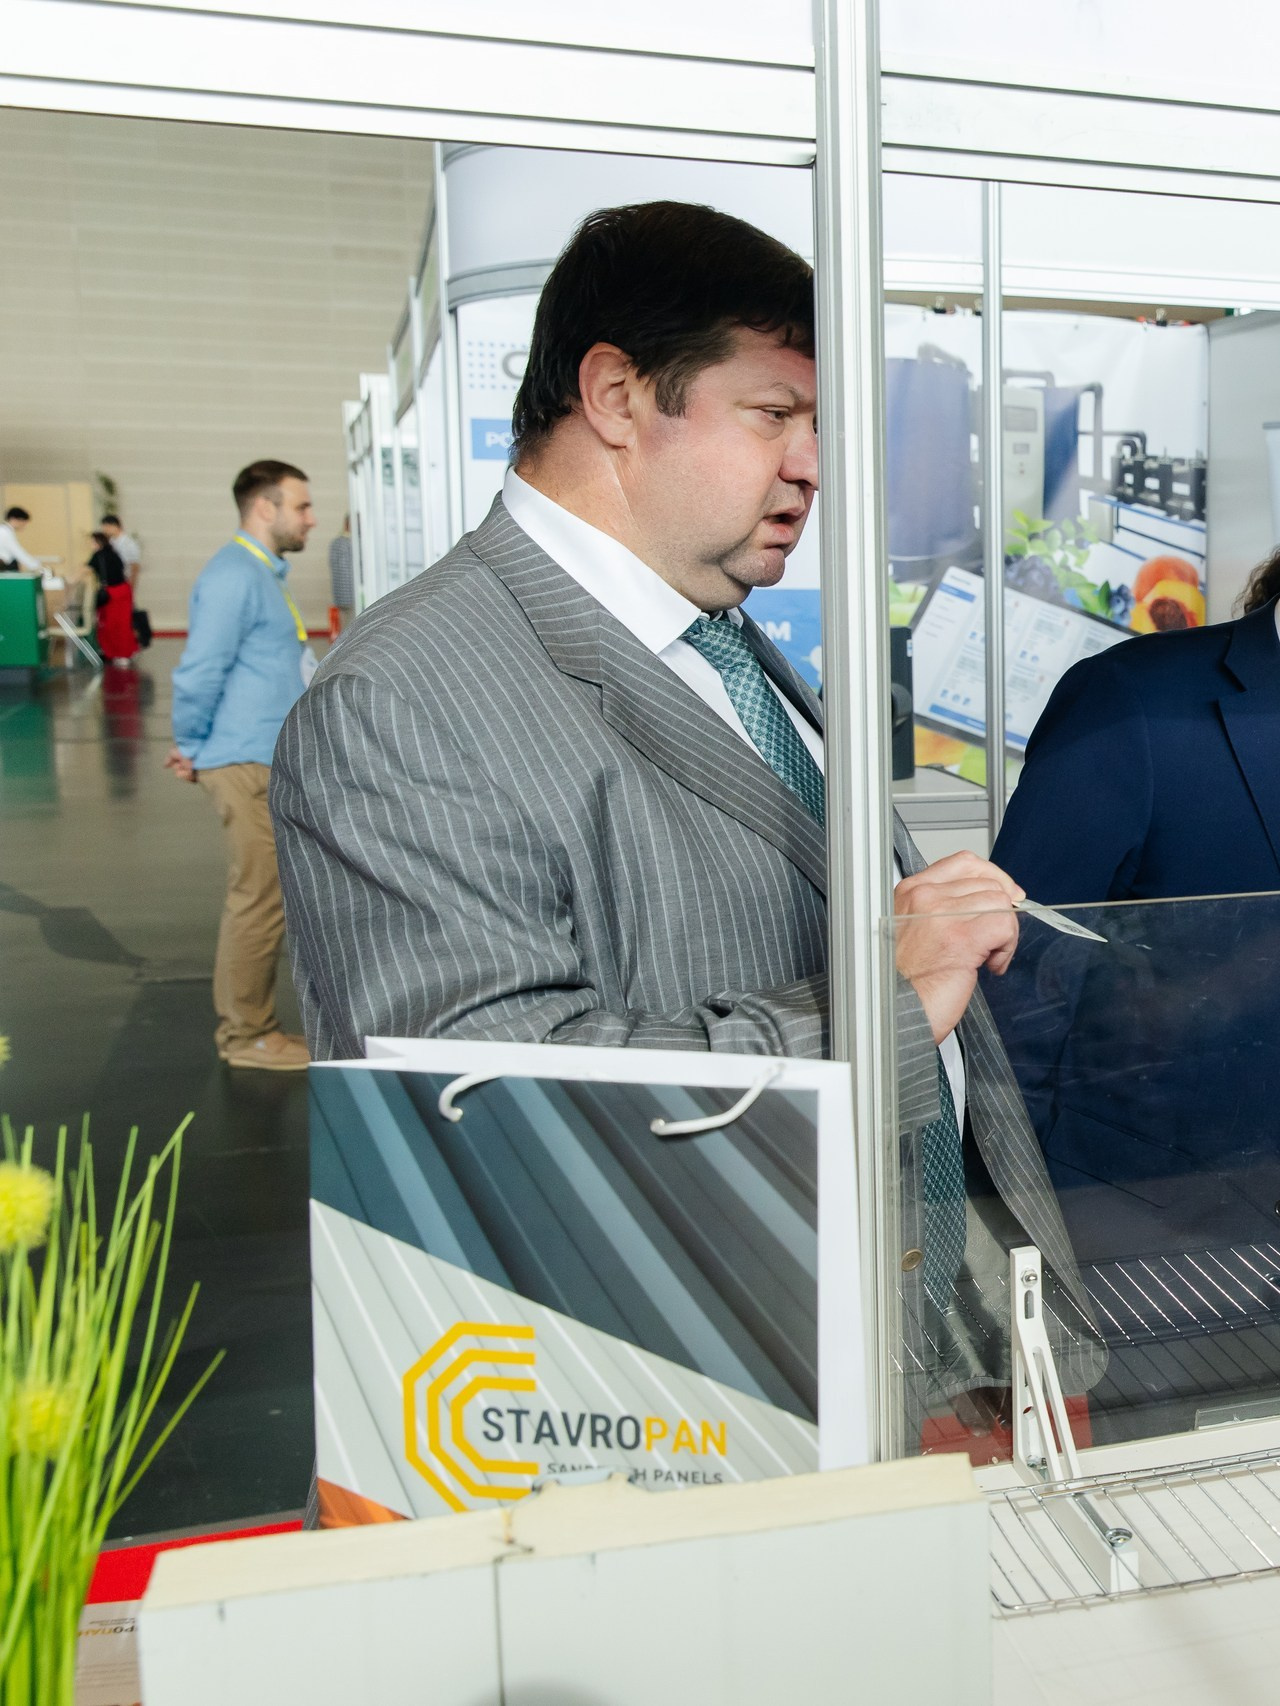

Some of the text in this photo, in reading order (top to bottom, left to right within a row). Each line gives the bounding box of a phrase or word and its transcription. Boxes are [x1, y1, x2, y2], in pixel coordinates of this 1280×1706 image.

[482, 1406, 728, 1457] STAVROPAN
[547, 1463, 723, 1484] SANH PANELS
